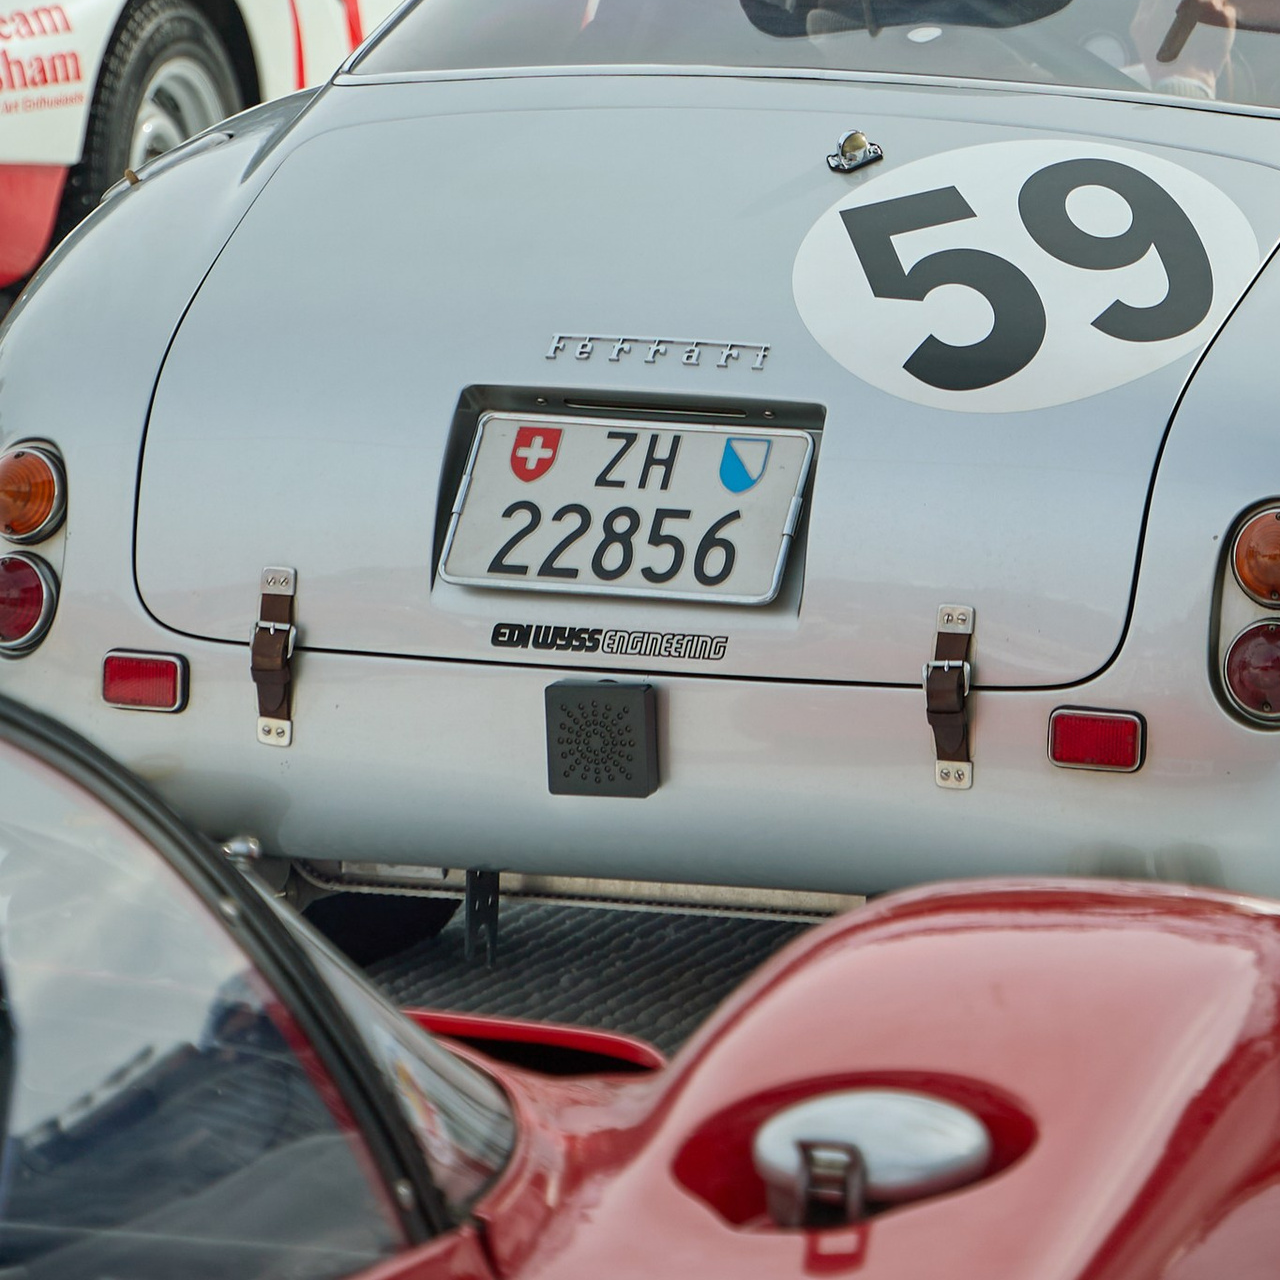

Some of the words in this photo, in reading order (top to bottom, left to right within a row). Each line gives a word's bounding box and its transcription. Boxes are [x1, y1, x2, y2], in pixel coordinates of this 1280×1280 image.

[0, 49, 82, 91] ham
[839, 157, 1214, 391] 59
[545, 333, 771, 370] Ferrari
[595, 431, 682, 490] ZH
[487, 500, 741, 587] 22856
[601, 629, 729, 660] ENGINEERING
